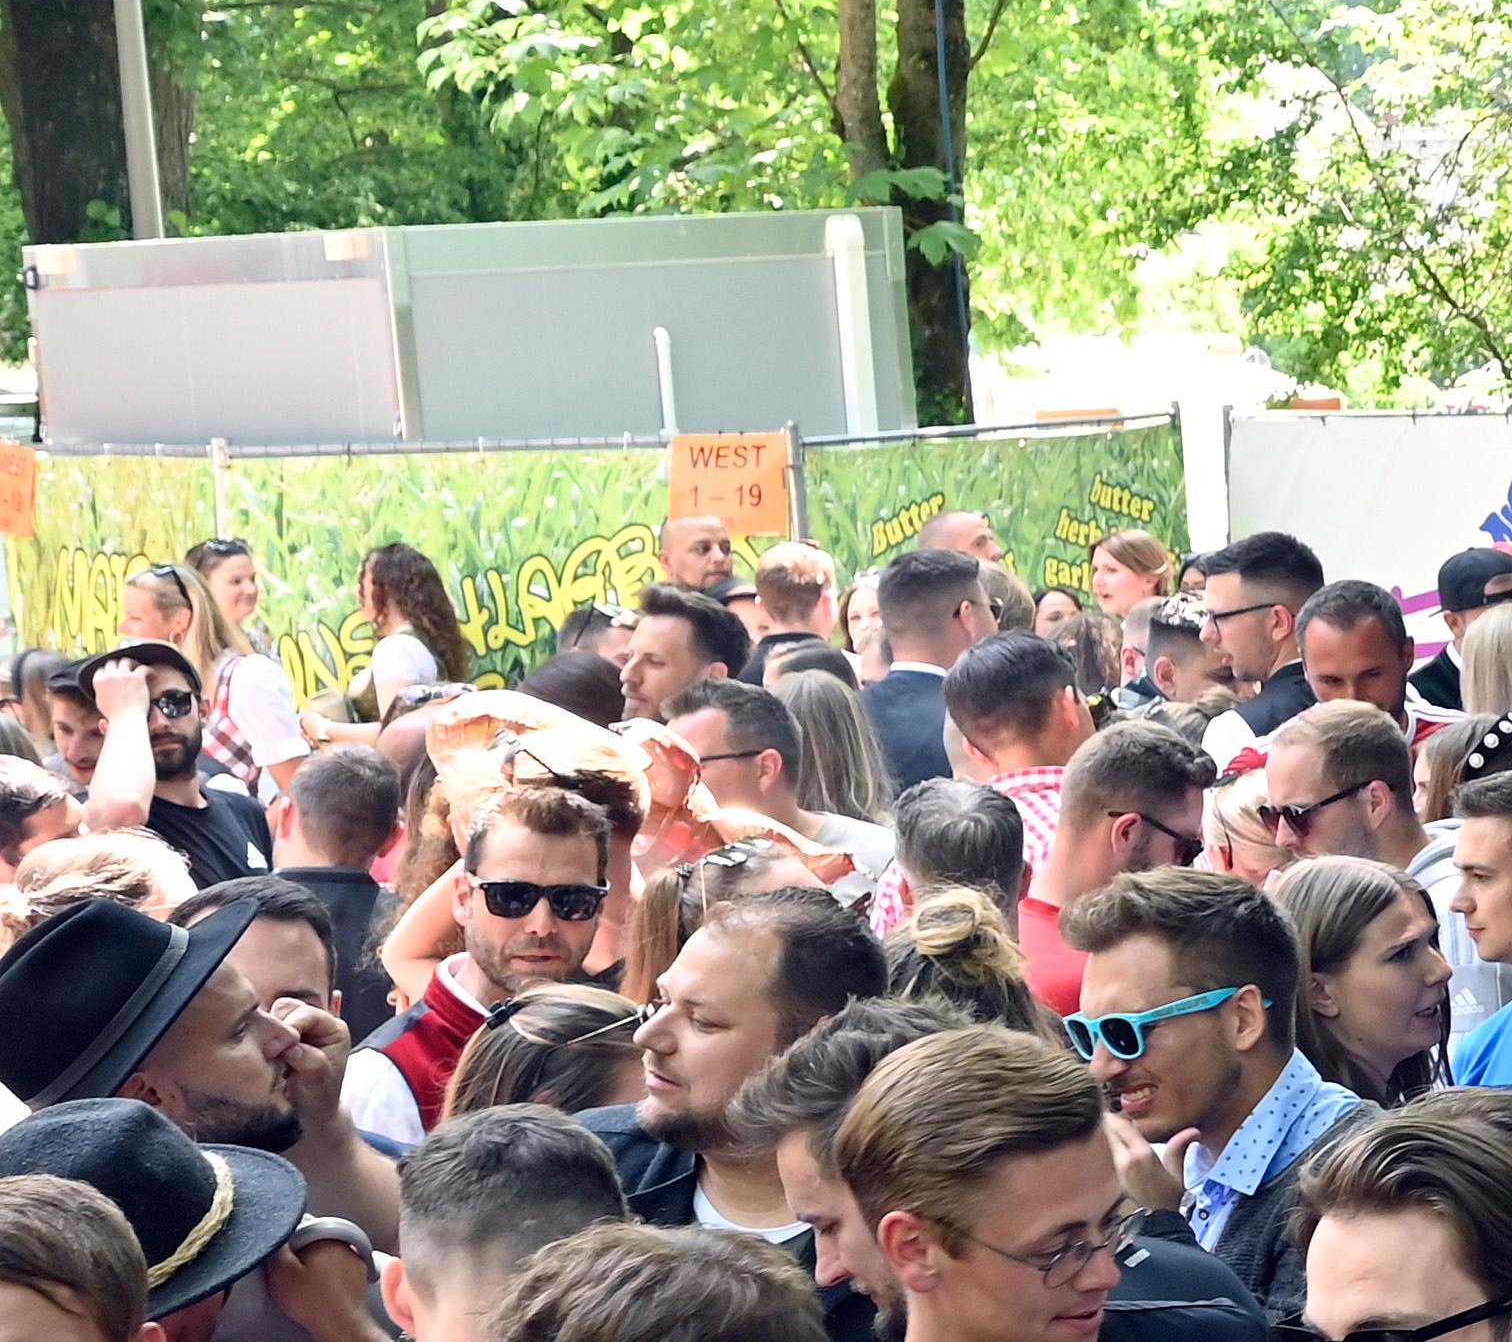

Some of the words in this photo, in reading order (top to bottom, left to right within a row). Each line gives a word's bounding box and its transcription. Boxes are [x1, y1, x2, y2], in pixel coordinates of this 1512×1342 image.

[689, 445, 767, 470] WEST
[689, 484, 699, 507] 1
[735, 483, 762, 507] 19
[1089, 473, 1156, 523] butter
[870, 491, 945, 558] Butter
